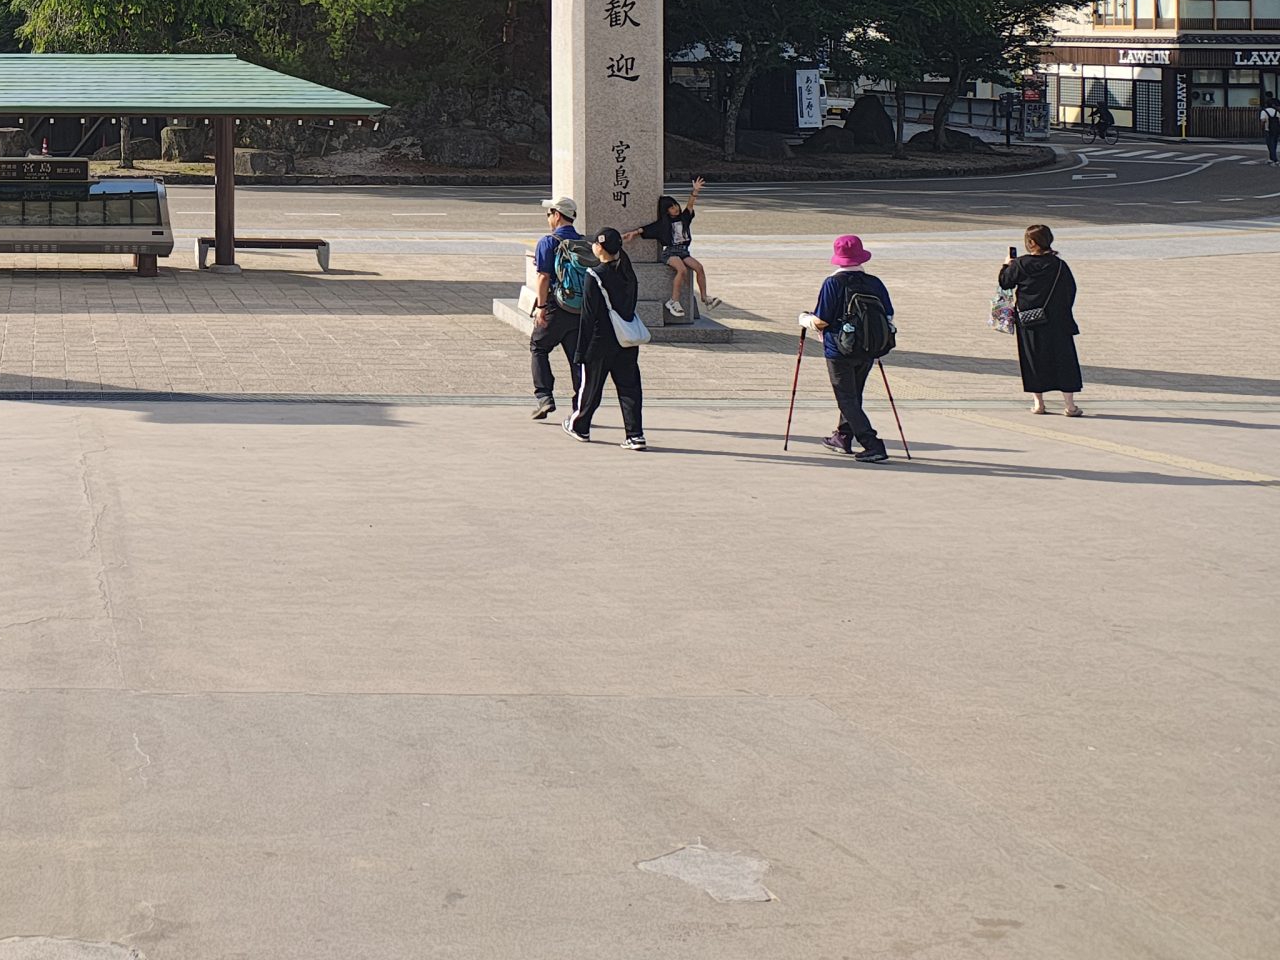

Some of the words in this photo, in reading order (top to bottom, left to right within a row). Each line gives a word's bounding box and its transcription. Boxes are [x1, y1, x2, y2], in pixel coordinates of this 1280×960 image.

[1118, 50, 1170, 65] LAWSON
[1177, 73, 1187, 126] LAWSON
[611, 141, 631, 208] 宮島町
